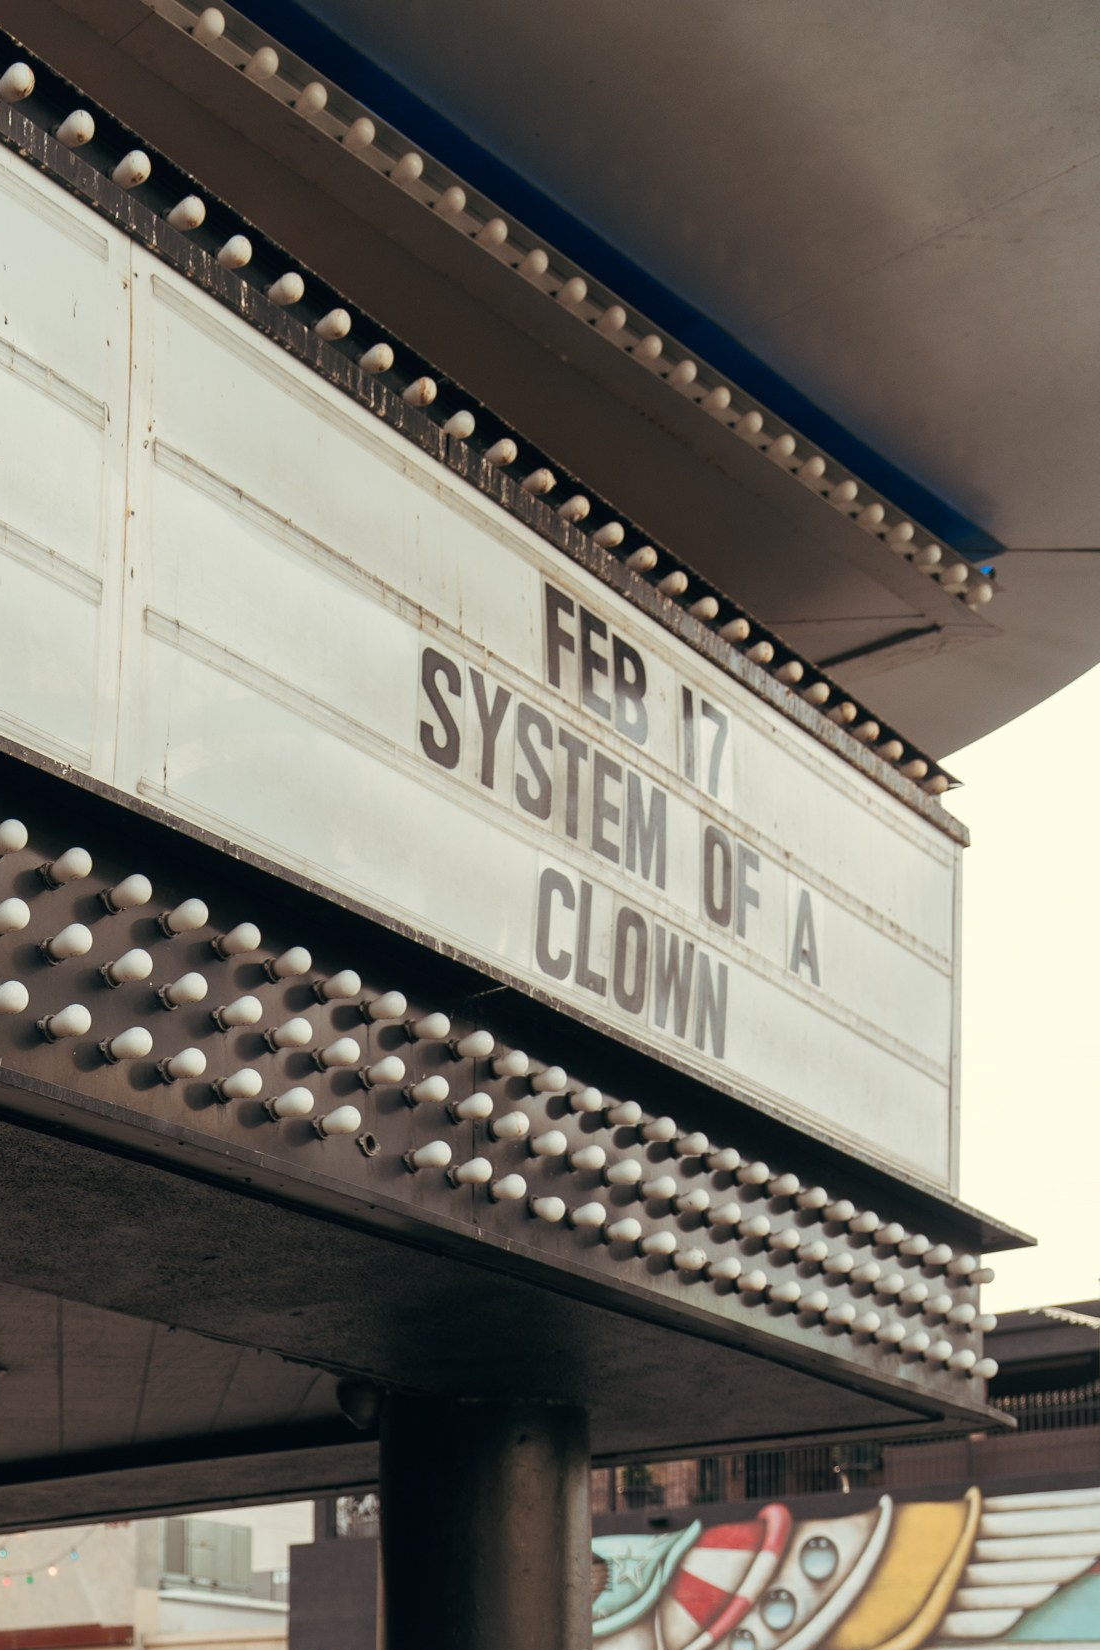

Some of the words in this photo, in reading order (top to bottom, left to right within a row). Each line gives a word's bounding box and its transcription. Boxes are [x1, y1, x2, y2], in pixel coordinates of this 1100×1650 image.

[545, 581, 648, 746] FEB
[681, 684, 729, 798] 17
[420, 647, 667, 891] SYSTEM
[703, 825, 761, 938] OF
[789, 889, 821, 987] A
[535, 867, 728, 1060] CLOWN
